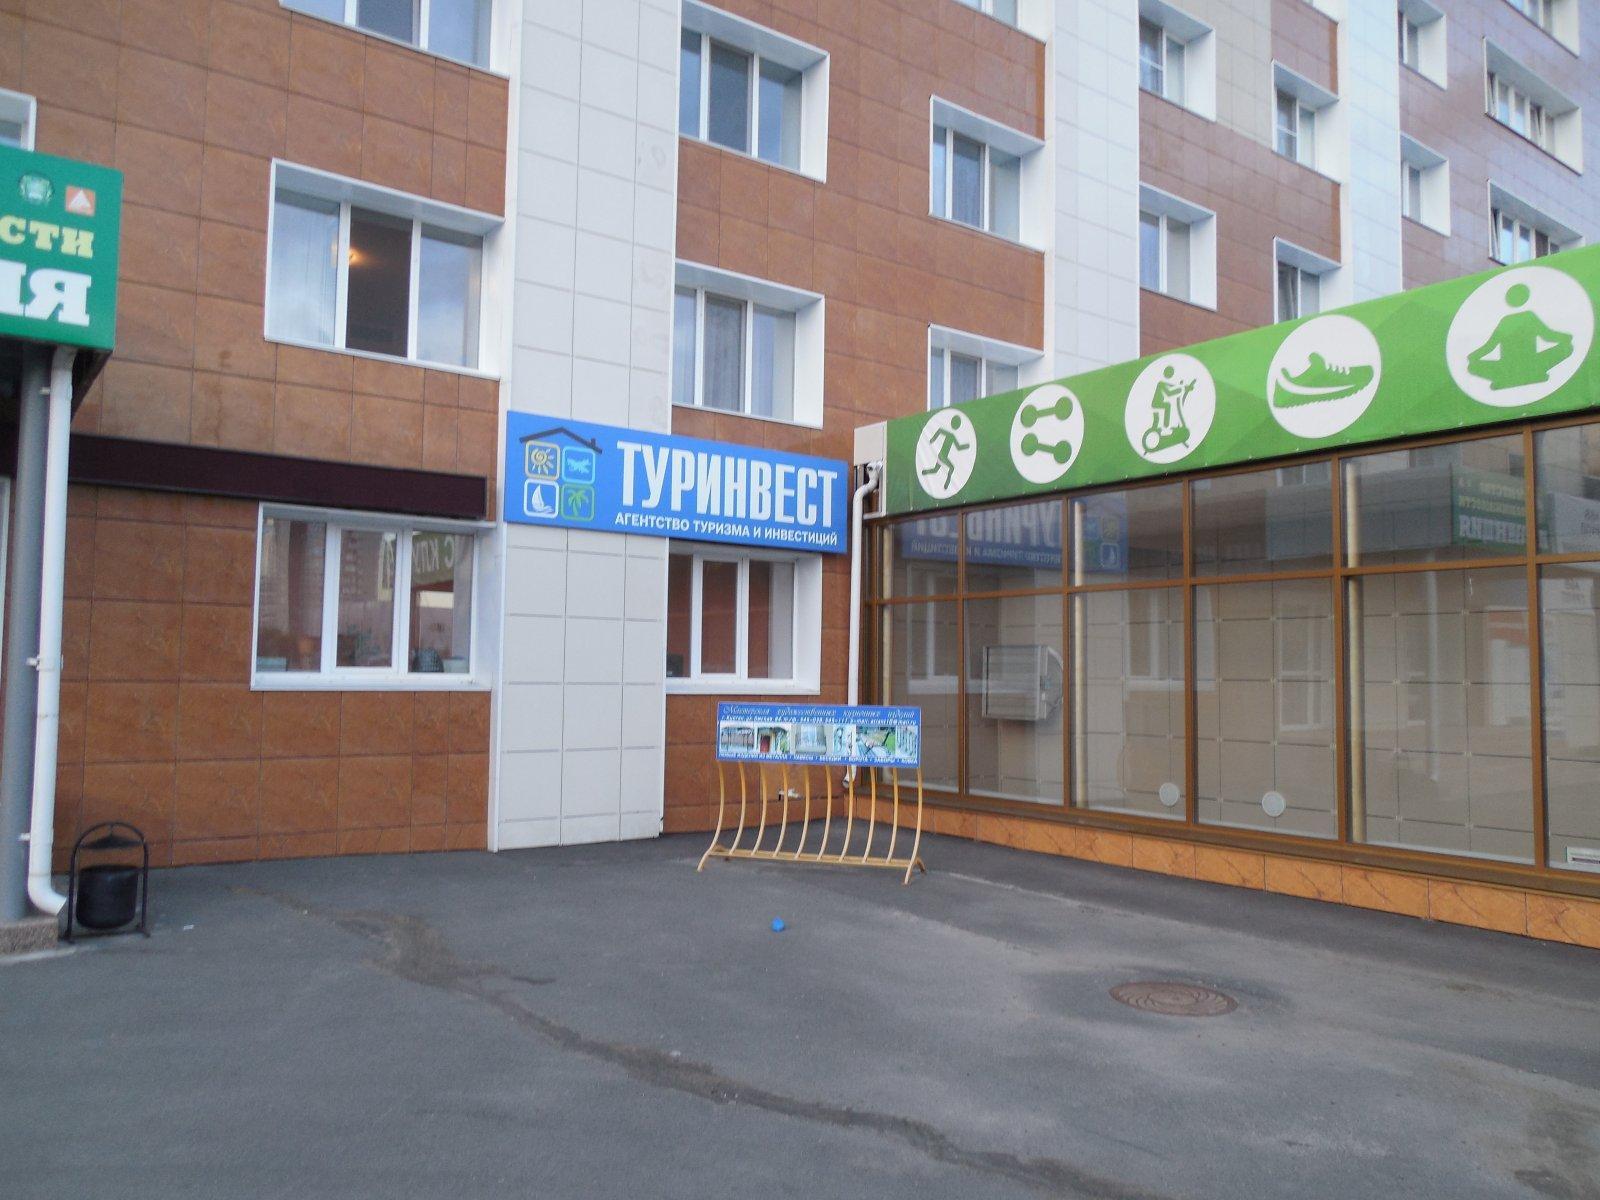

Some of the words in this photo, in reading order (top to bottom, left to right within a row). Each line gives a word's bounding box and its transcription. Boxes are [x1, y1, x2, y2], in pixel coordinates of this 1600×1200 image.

[616, 440, 838, 528] ТУРИНВЕСТ
[614, 513, 690, 532] АГЕНТСТВО
[692, 520, 750, 537] ТУРИЗМА
[753, 527, 761, 539] И
[764, 527, 838, 546] ИНВЕСТИЦИЙ
